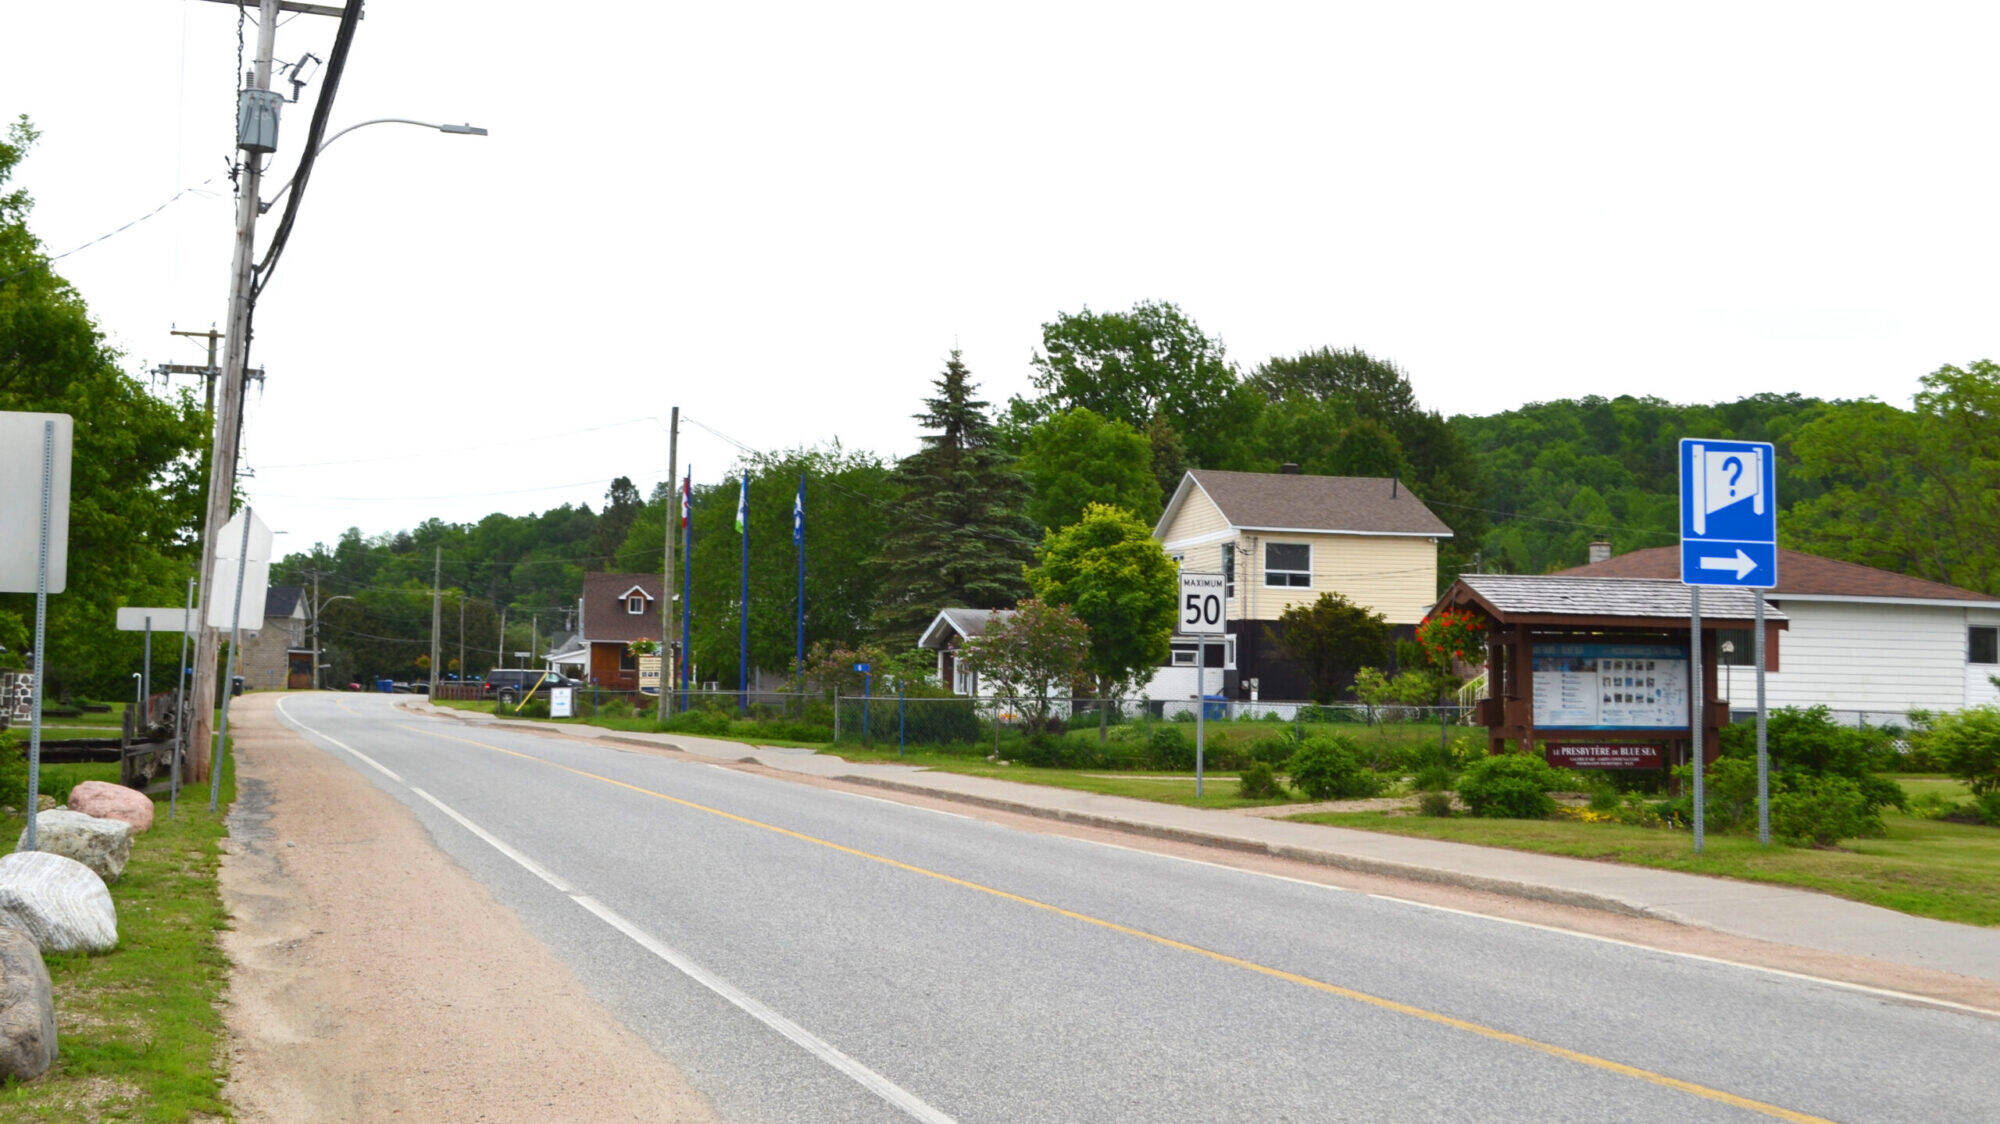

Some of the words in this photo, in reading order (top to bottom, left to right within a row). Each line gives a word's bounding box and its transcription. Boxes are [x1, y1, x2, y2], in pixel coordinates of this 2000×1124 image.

[1183, 579, 1223, 587] MAXIMUM
[1185, 594, 1221, 625] 50
[1561, 745, 1611, 756] PRESBYTÈRE
[1620, 747, 1640, 756] BLUE
[1641, 747, 1656, 756] SEA
